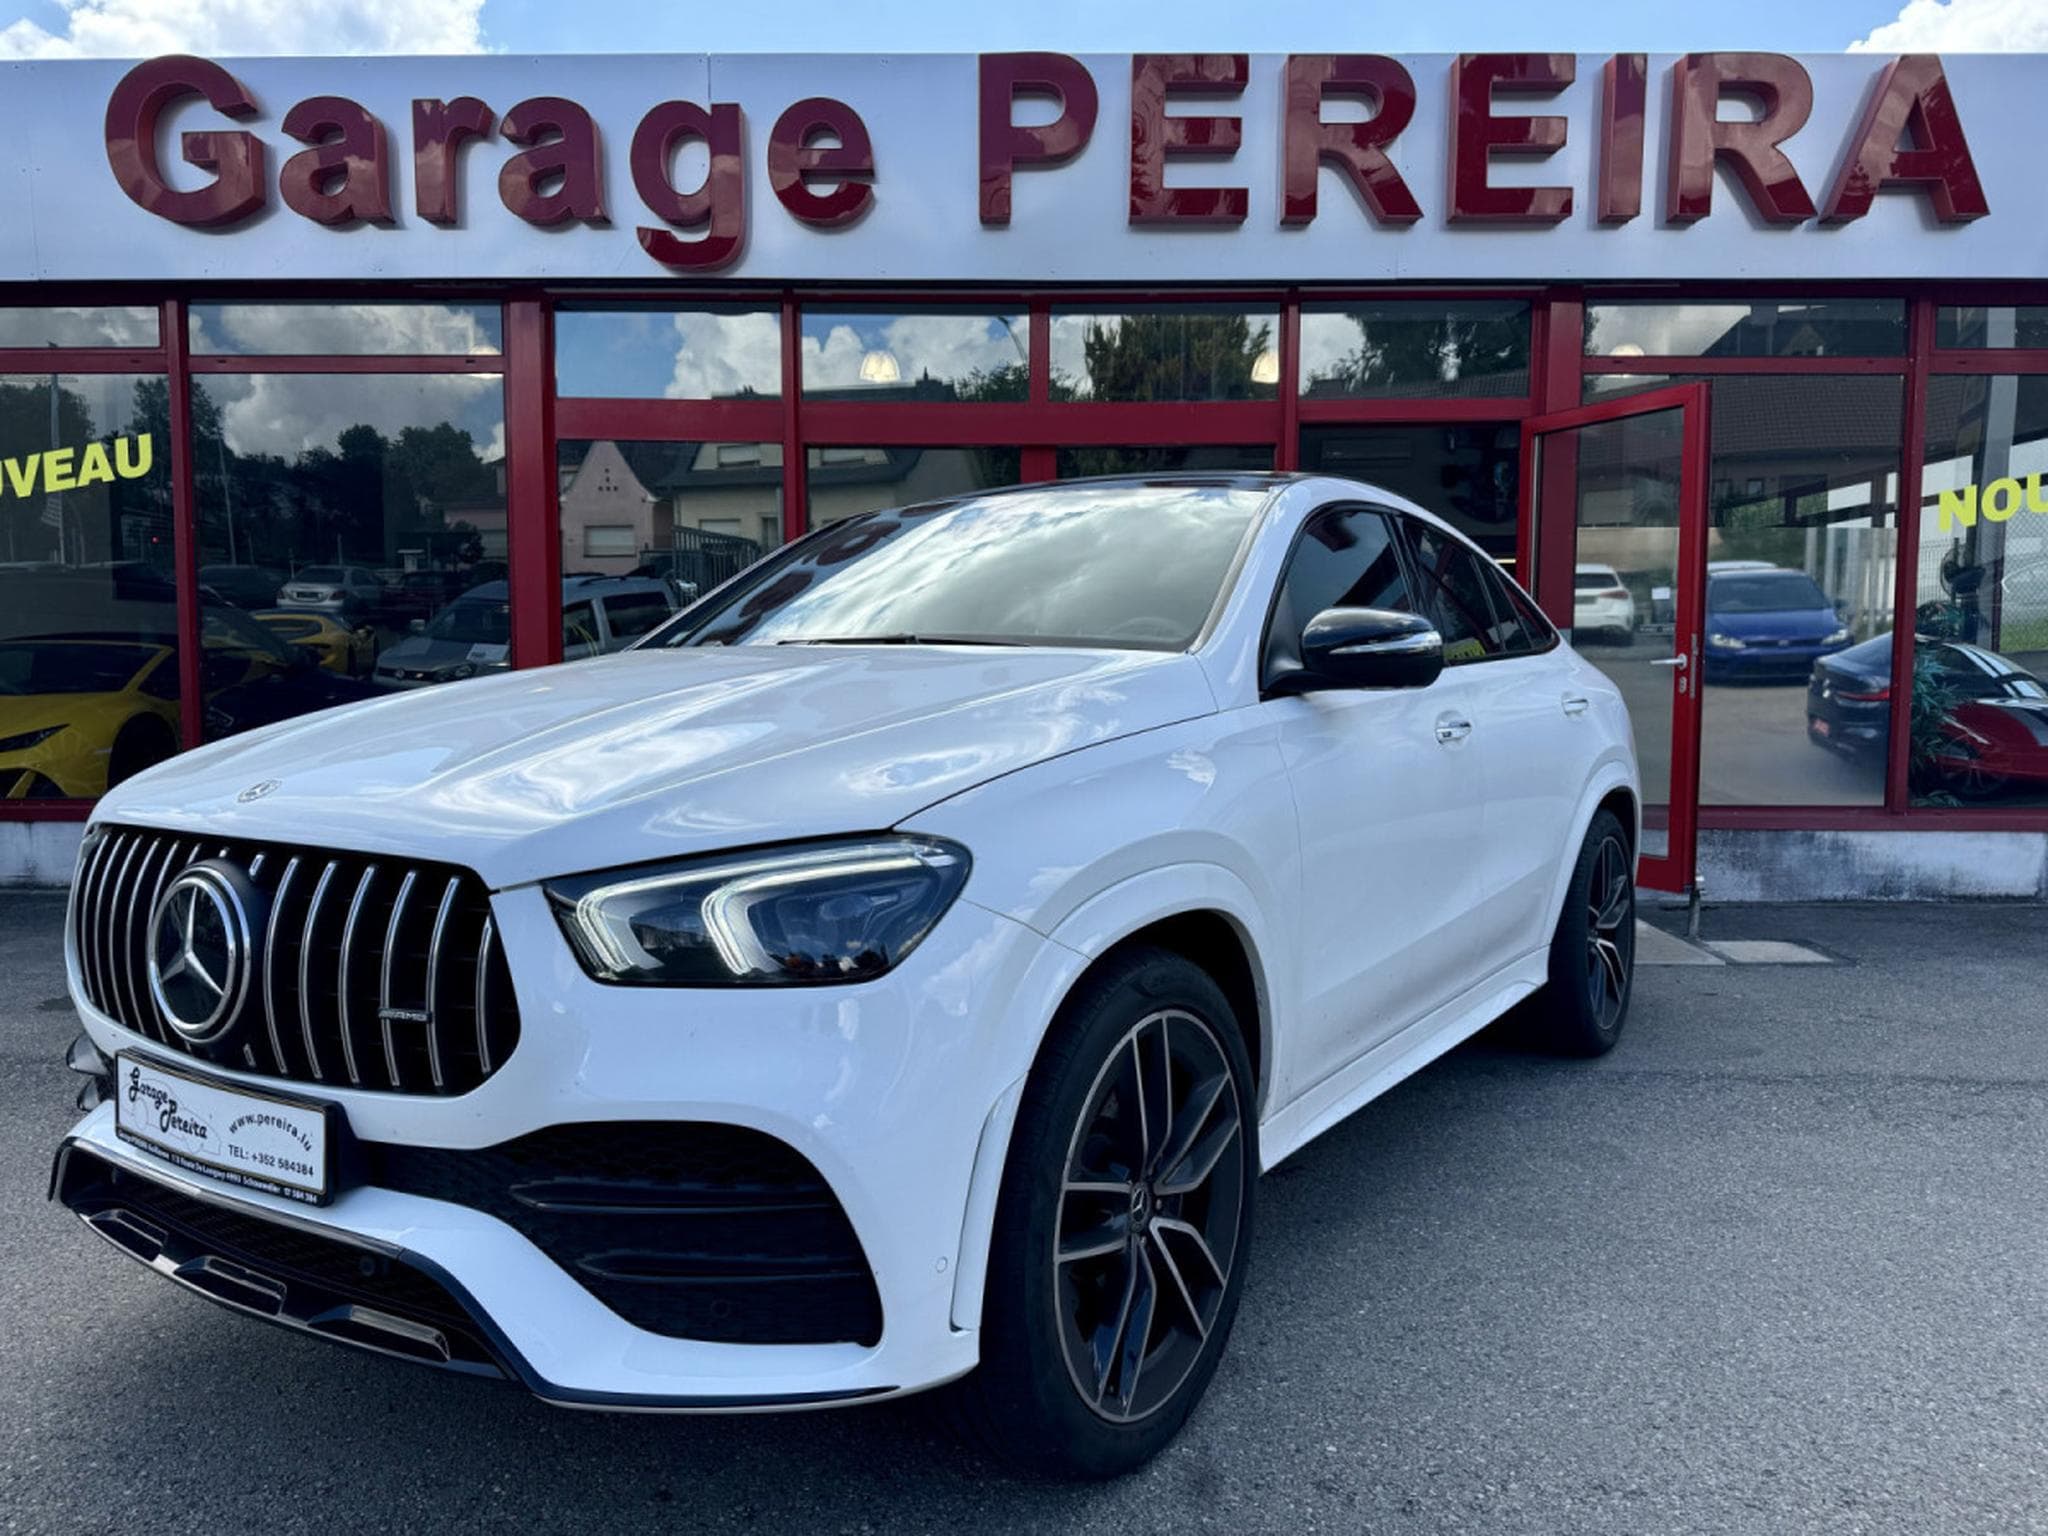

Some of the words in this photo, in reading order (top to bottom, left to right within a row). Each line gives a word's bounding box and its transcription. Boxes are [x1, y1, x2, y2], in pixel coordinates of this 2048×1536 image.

[105, 54, 874, 271] Garage
[978, 52, 1990, 228] PEREIRA
[0, 432, 153, 498] VEAU
[129, 1066, 168, 1110] Garage
[160, 1099, 208, 1139] Pereira
[229, 1113, 312, 1151] www.pereira.lu
[228, 1143, 249, 1160] TEL:
[252, 1151, 275, 1167] +352
[277, 1157, 314, 1176] 584384
